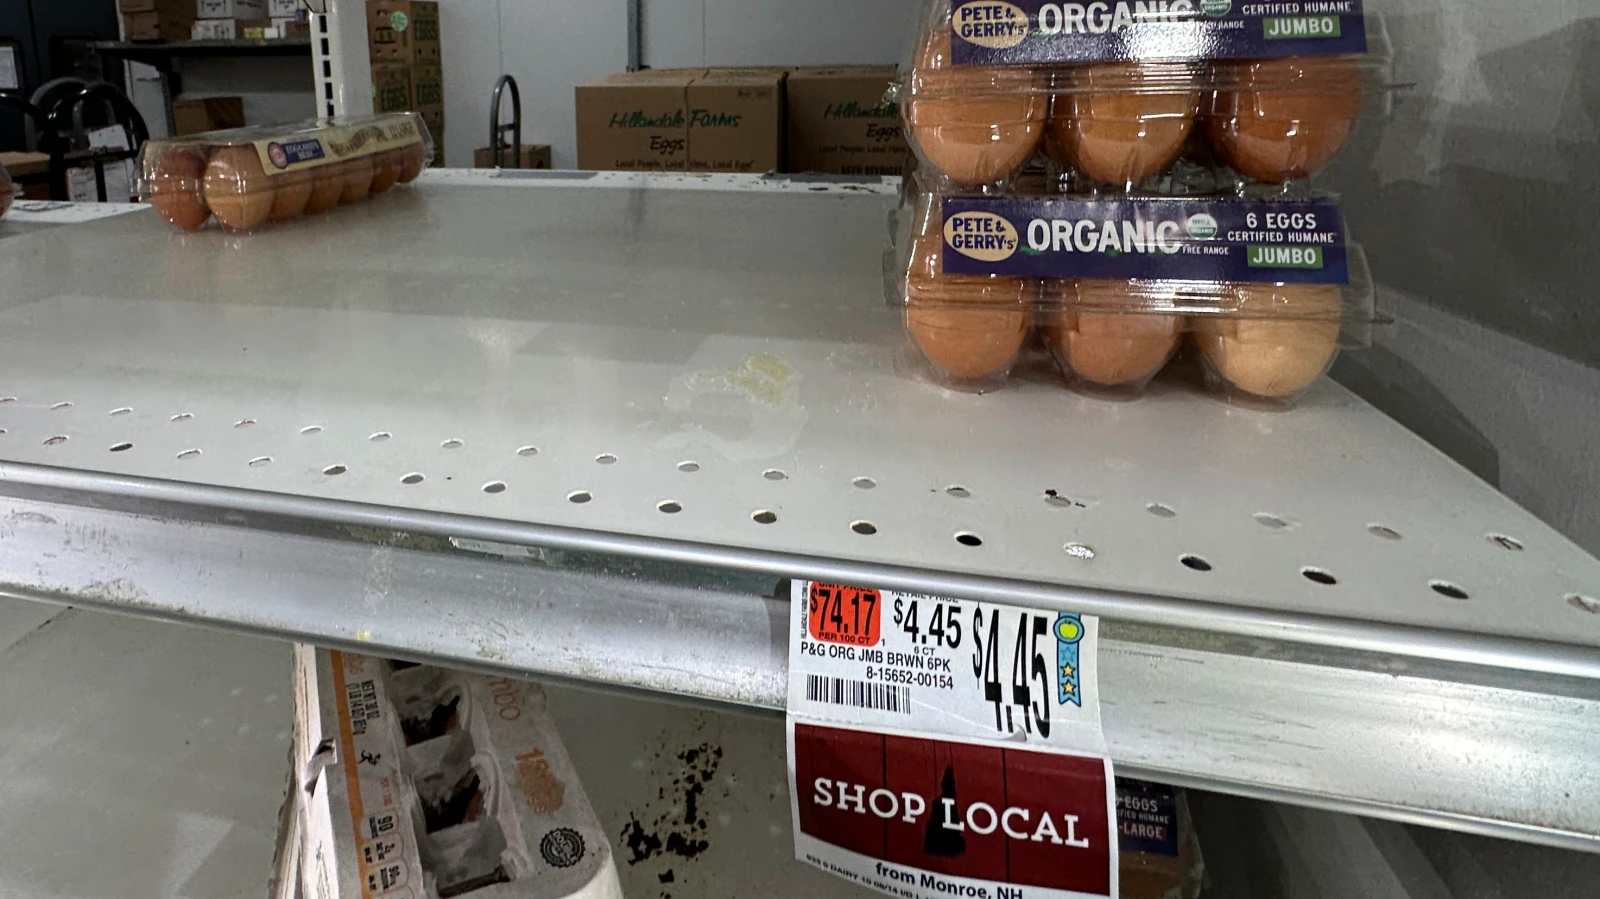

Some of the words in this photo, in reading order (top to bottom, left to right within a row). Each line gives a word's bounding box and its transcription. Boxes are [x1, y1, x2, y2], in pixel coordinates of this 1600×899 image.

[961, 6, 1001, 21] PETE
[1005, 7, 1017, 20] &
[1038, 0, 1194, 34] ORGANIC
[1242, 4, 1299, 15] CERTIFIED
[1305, 2, 1351, 13] HUMANE
[1269, 17, 1333, 36] JUMBO
[689, 109, 742, 128] Farms
[866, 123, 901, 142] Eggs
[650, 136, 685, 155] Eggs
[952, 217, 992, 232] PETE
[995, 221, 1006, 232] &
[1246, 212, 1258, 229] 6
[1266, 213, 1317, 230] EGGS
[1027, 218, 1181, 254] ORGANIC
[1227, 231, 1283, 243] CERTIFIED
[1288, 232, 1335, 243] HUMANE
[1182, 245, 1201, 255] FREE
[1204, 247, 1229, 256] RANGE
[1253, 249, 1317, 265] JUMBO
[809, 586, 877, 637] $74.17
[893, 597, 962, 649] $4.45
[818, 631, 837, 641] PER
[840, 634, 856, 643] 100
[858, 637, 871, 645] CT
[801, 641, 826, 657] P&G
[828, 645, 855, 660] ORG
[858, 648, 883, 664] JMB
[887, 652, 924, 670] BRWN
[927, 657, 951, 673] 6PK
[914, 646, 920, 655] 6
[922, 647, 936, 656] CT
[866, 666, 954, 690] 8-15652-00154
[972, 601, 1051, 738] $4.45
[814, 777, 925, 824] SHOP
[941, 797, 1089, 849] LOCAL
[1125, 796, 1158, 813] EGGS
[377, 815, 394, 832] 90
[1139, 813, 1170, 825] HUMANE
[1119, 821, 1163, 840] -LARGE
[876, 862, 915, 885] from
[920, 873, 992, 899] Monroe,
[997, 887, 1023, 899] NH
